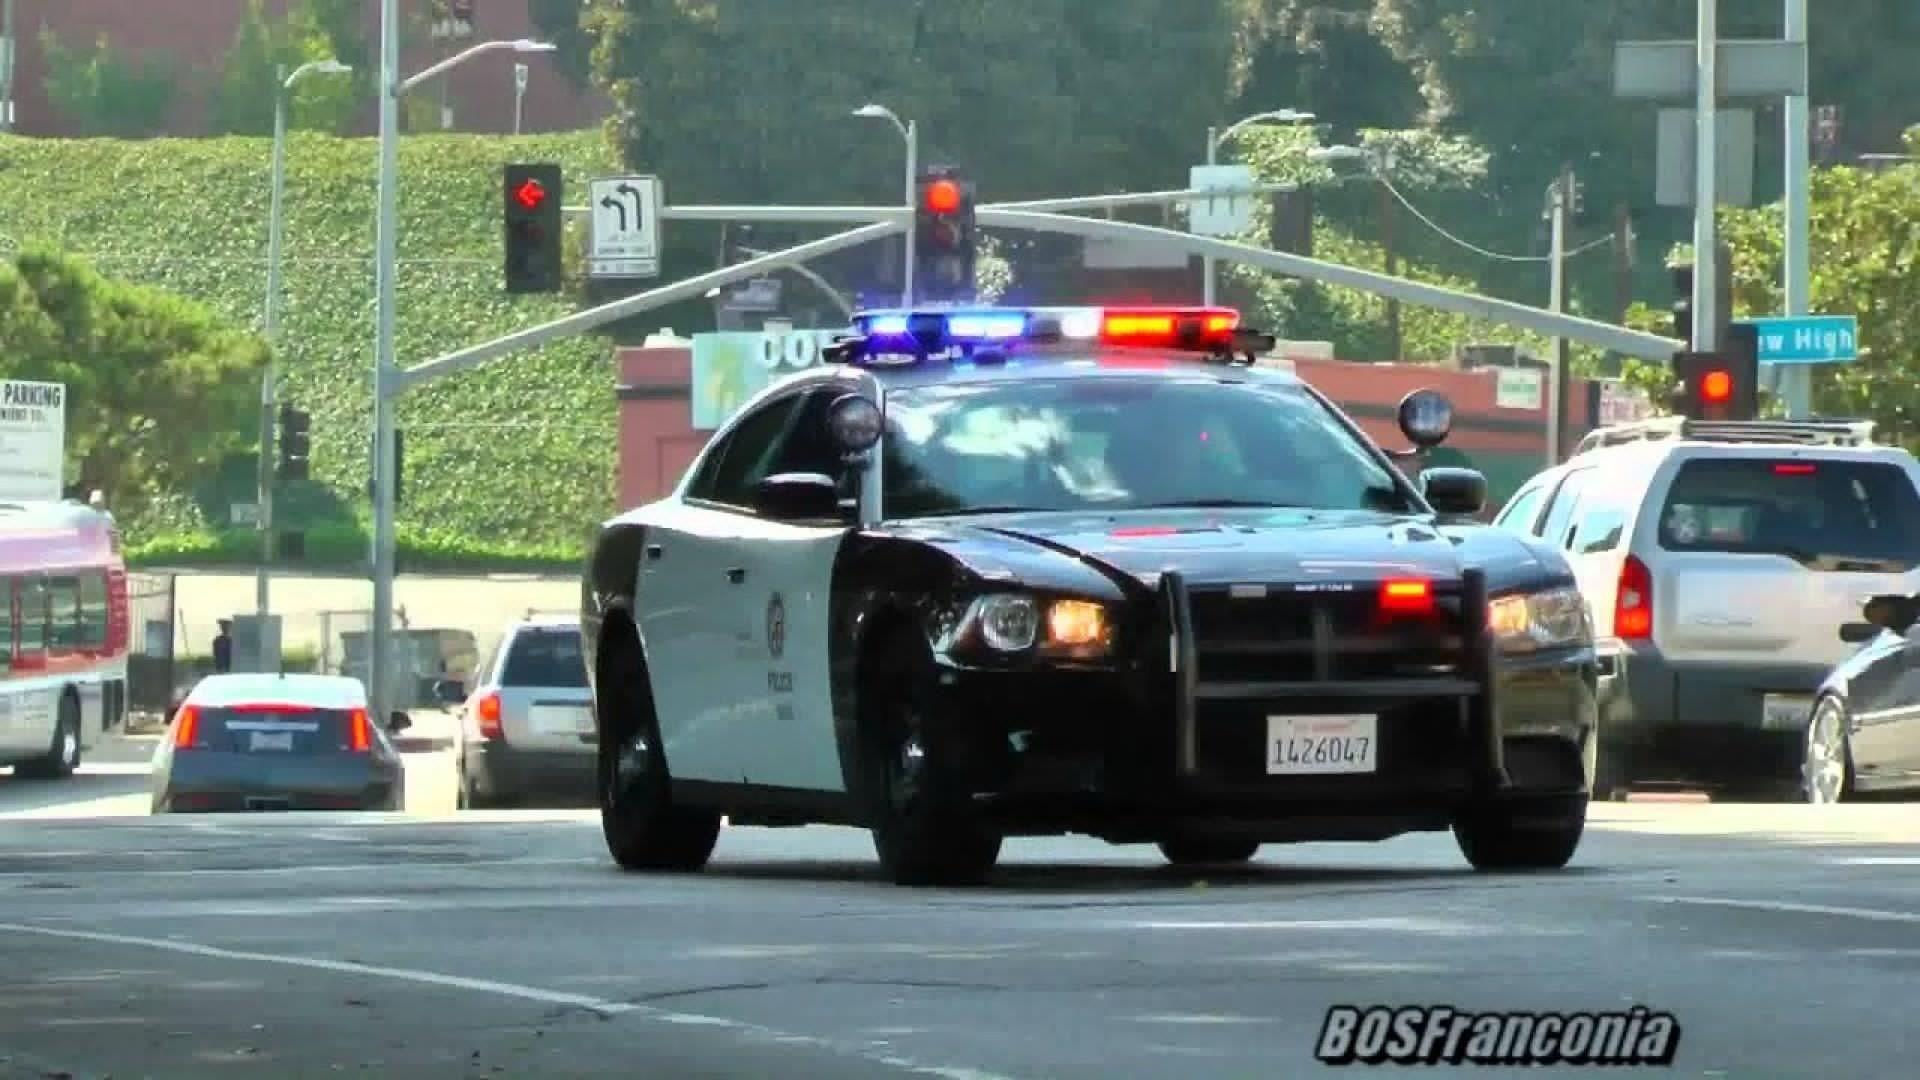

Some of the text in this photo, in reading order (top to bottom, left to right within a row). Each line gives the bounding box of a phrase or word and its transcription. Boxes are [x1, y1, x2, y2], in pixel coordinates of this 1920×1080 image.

[1794, 327, 1852, 358] High
[4, 383, 61, 408] PARKING
[1272, 737, 1370, 764] 1426047
